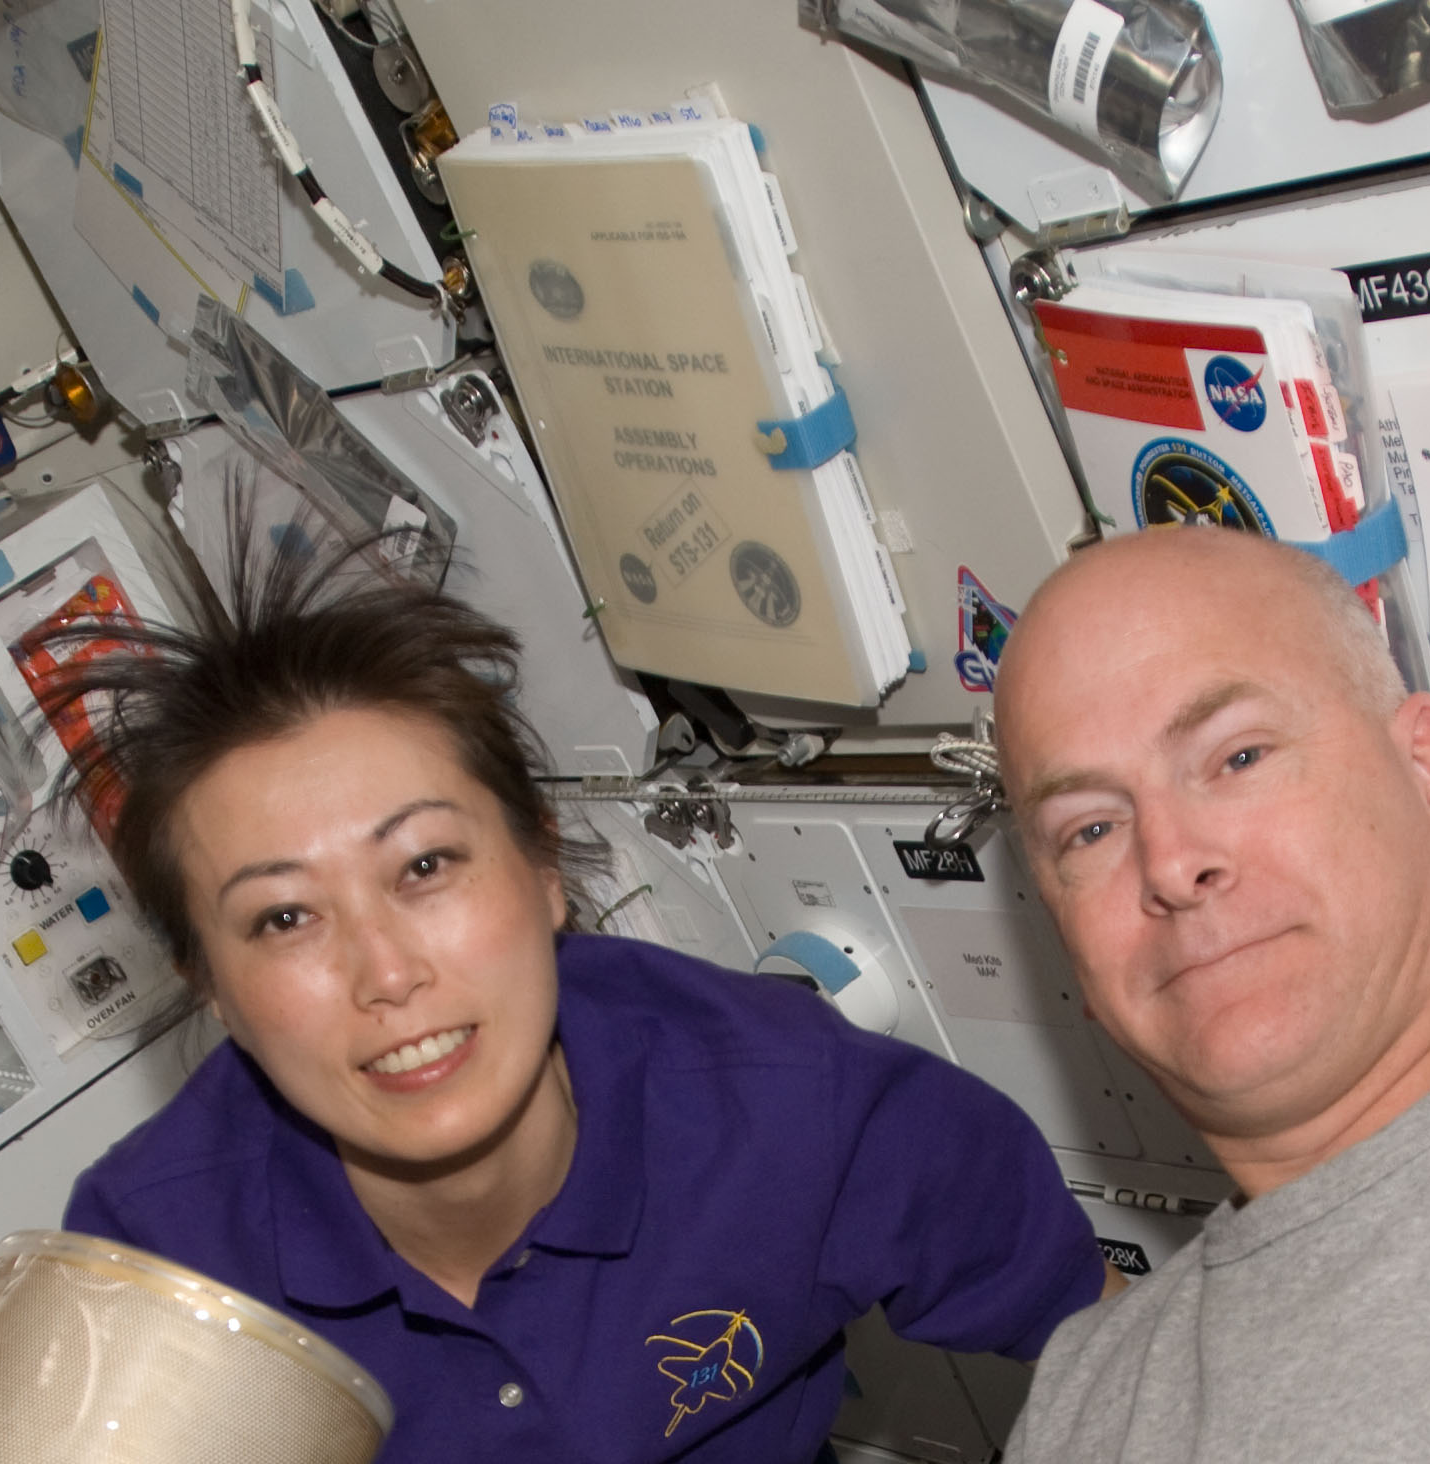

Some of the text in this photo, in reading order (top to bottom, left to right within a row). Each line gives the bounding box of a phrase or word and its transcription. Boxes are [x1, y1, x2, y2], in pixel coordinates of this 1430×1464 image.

[542, 344, 729, 373] INTERNATIONAL SPACE
[1095, 366, 1129, 378] NATIONAL
[604, 376, 674, 398] STATION
[1208, 384, 1264, 404] NASA
[614, 427, 697, 449] ASSEMBLY
[614, 452, 717, 476] OPERATIONS
[643, 492, 701, 551] Return on
[669, 520, 720, 576] STS-131
[903, 849, 974, 873] MF28H
[39, 903, 74, 930] WATER
[86, 991, 137, 1030] OVEN FAN
[690, 1363, 719, 1388] 131
